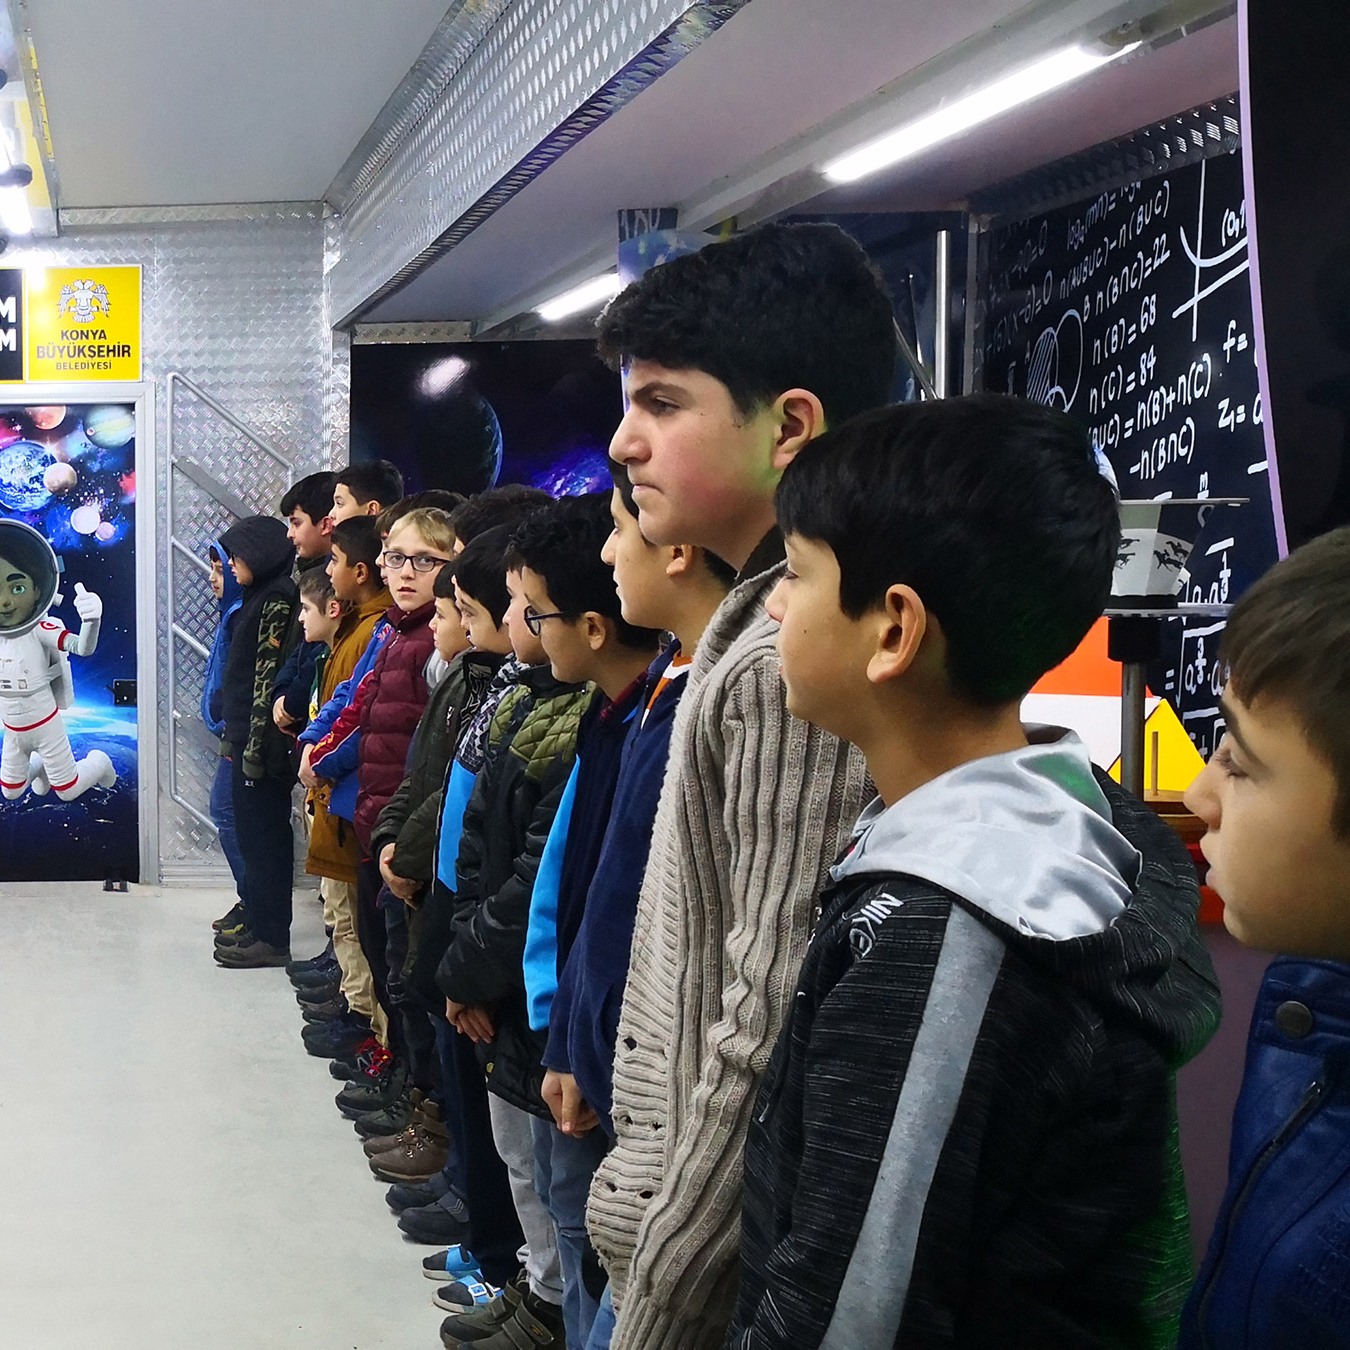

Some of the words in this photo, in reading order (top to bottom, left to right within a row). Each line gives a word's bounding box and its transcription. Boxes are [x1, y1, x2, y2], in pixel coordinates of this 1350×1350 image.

[60, 329, 107, 341] KONYA
[36, 341, 131, 360] BÜYÜKŞEHİR
[55, 359, 112, 370] BELEDİYESİ
